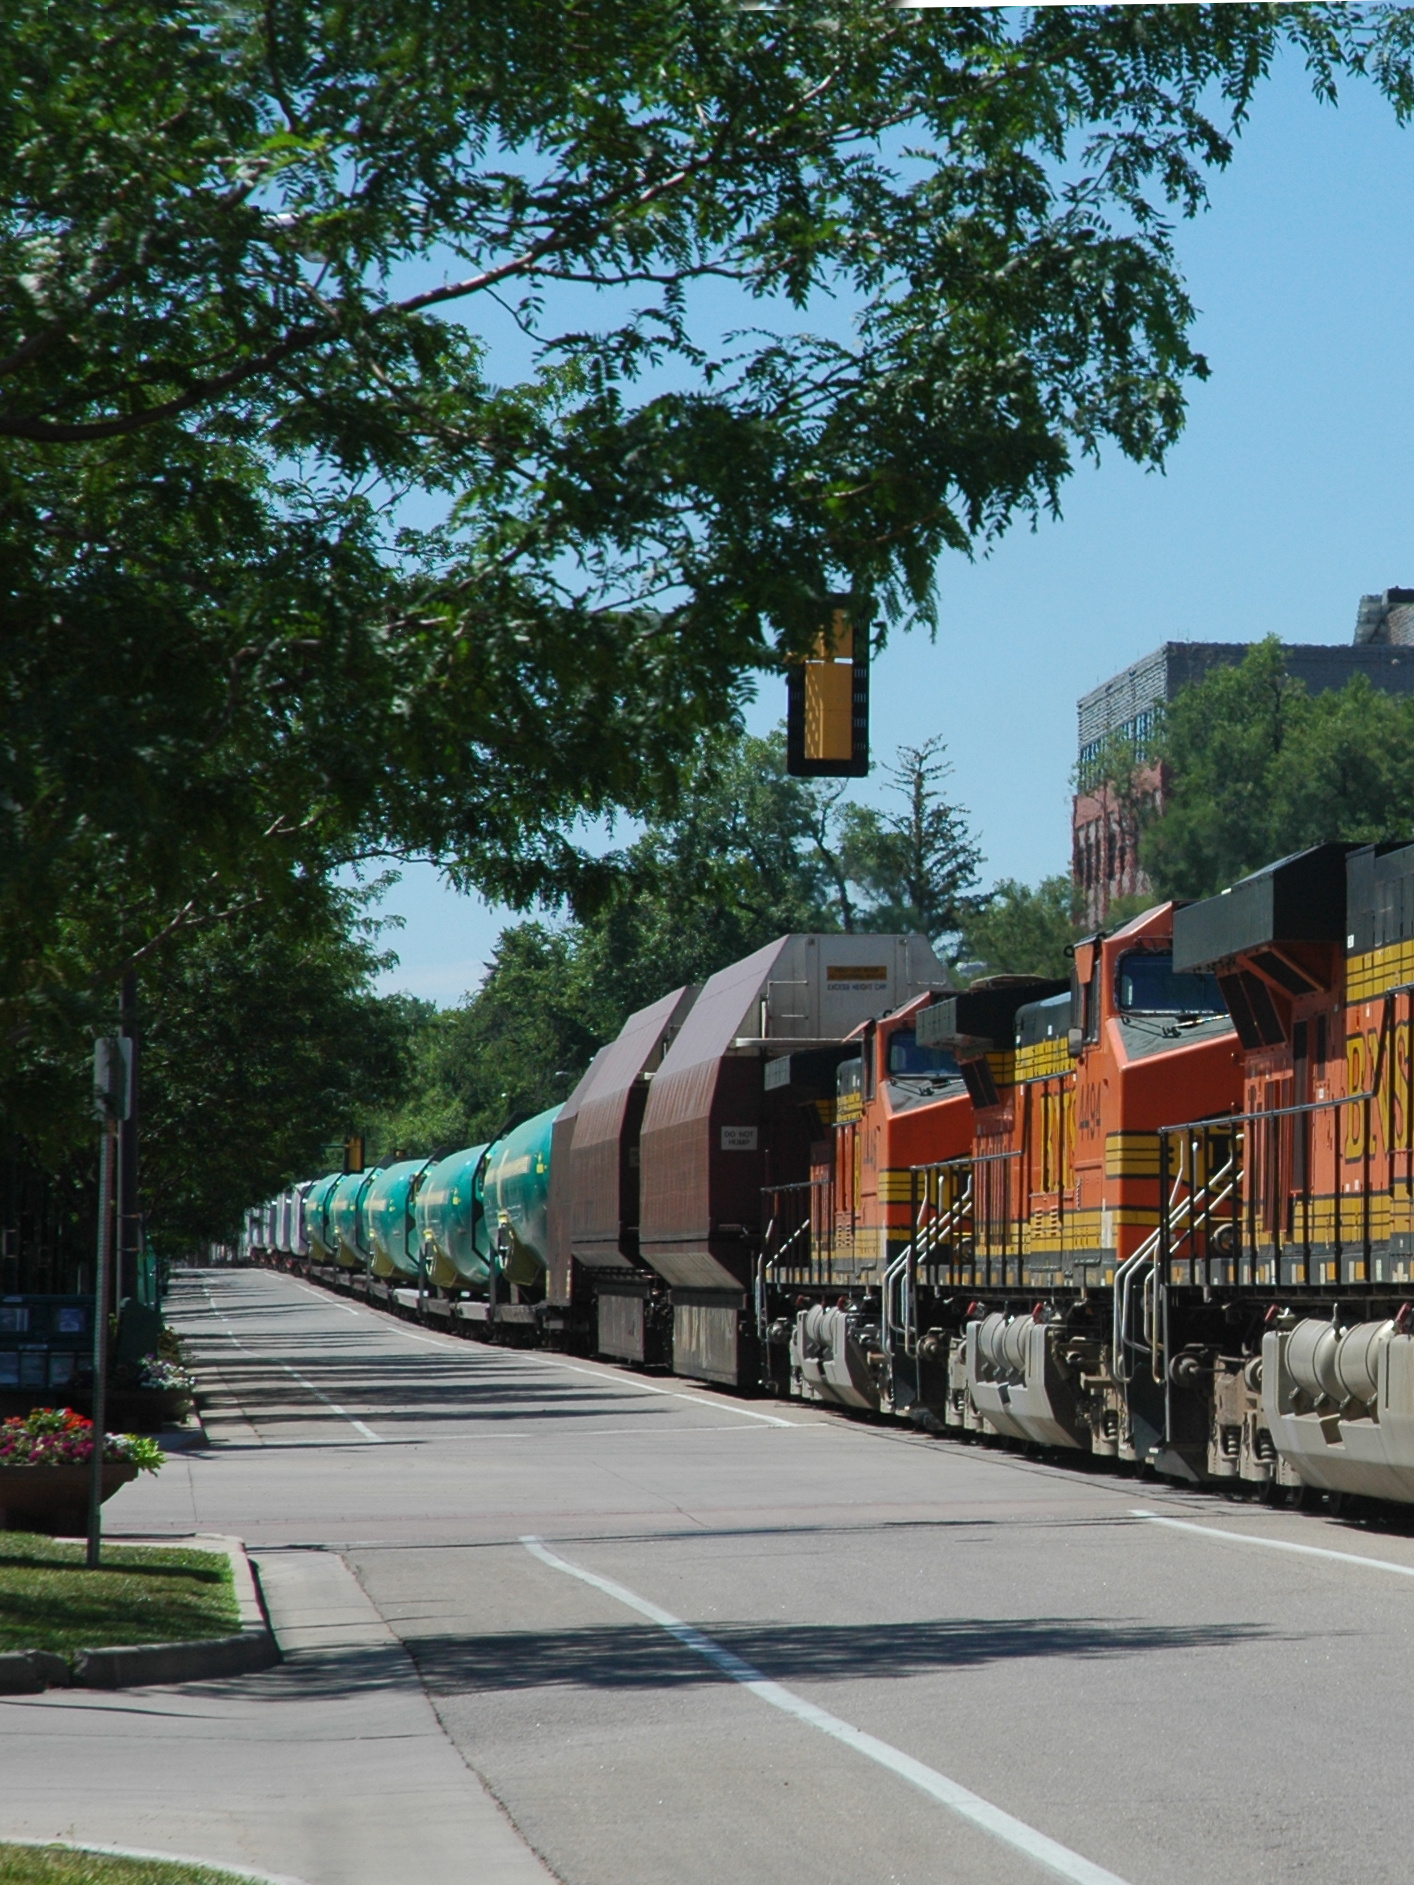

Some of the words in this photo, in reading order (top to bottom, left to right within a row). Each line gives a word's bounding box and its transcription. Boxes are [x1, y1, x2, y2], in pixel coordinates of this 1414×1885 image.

[724, 1130, 736, 1138] DO
[738, 1130, 754, 1138] NOT
[728, 1138, 751, 1146] HUMP
